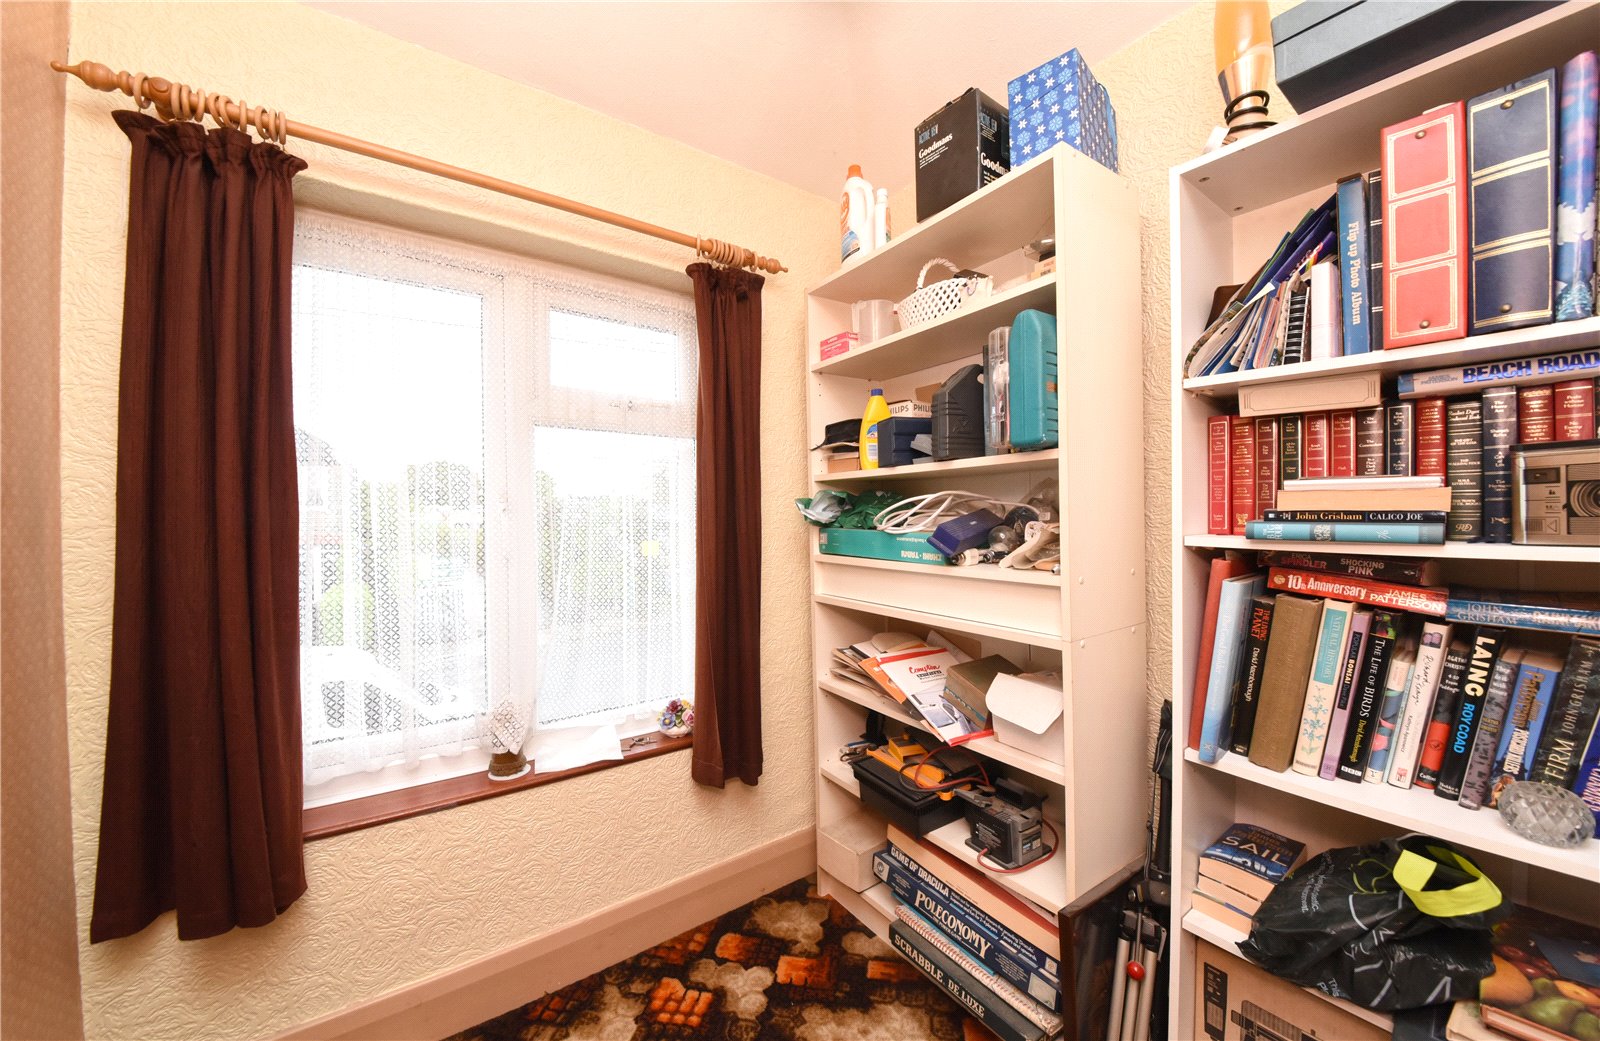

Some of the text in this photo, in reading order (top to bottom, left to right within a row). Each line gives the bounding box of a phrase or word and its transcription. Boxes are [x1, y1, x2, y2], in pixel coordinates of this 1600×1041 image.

[919, 133, 953, 159] Goodmans
[1346, 221, 1362, 324] Flip up Photo Album
[1463, 351, 1600, 383] BEACH ROAD
[1406, 513, 1423, 521] JOE
[1340, 558, 1385, 570] SHOCKING
[1348, 566, 1373, 577] PINK
[1287, 574, 1367, 599] 10th Anniversary
[1386, 589, 1427, 601] JAMES
[1369, 594, 1445, 612] PATTERSON
[1467, 603, 1502, 614] JOHN
[1251, 607, 1264, 639] PLANET
[1457, 613, 1517, 625] GRISHAM
[1375, 639, 1385, 657] THE
[1346, 658, 1355, 685] BONSAI
[1372, 657, 1381, 675] LIFE
[1368, 675, 1376, 687] OF
[1361, 686, 1375, 718] BIRDS
[1453, 635, 1496, 754] LAING ROY COAD
[1561, 660, 1593, 735] JOHN GRISHAM
[1545, 738, 1575, 780] FIRM
[1222, 836, 1287, 867] SAIL
[891, 845, 949, 897] GAME OF DRACULA
[914, 889, 992, 959] POLECONOMY
[894, 935, 985, 1017] SCRABBLE DE LUXE
